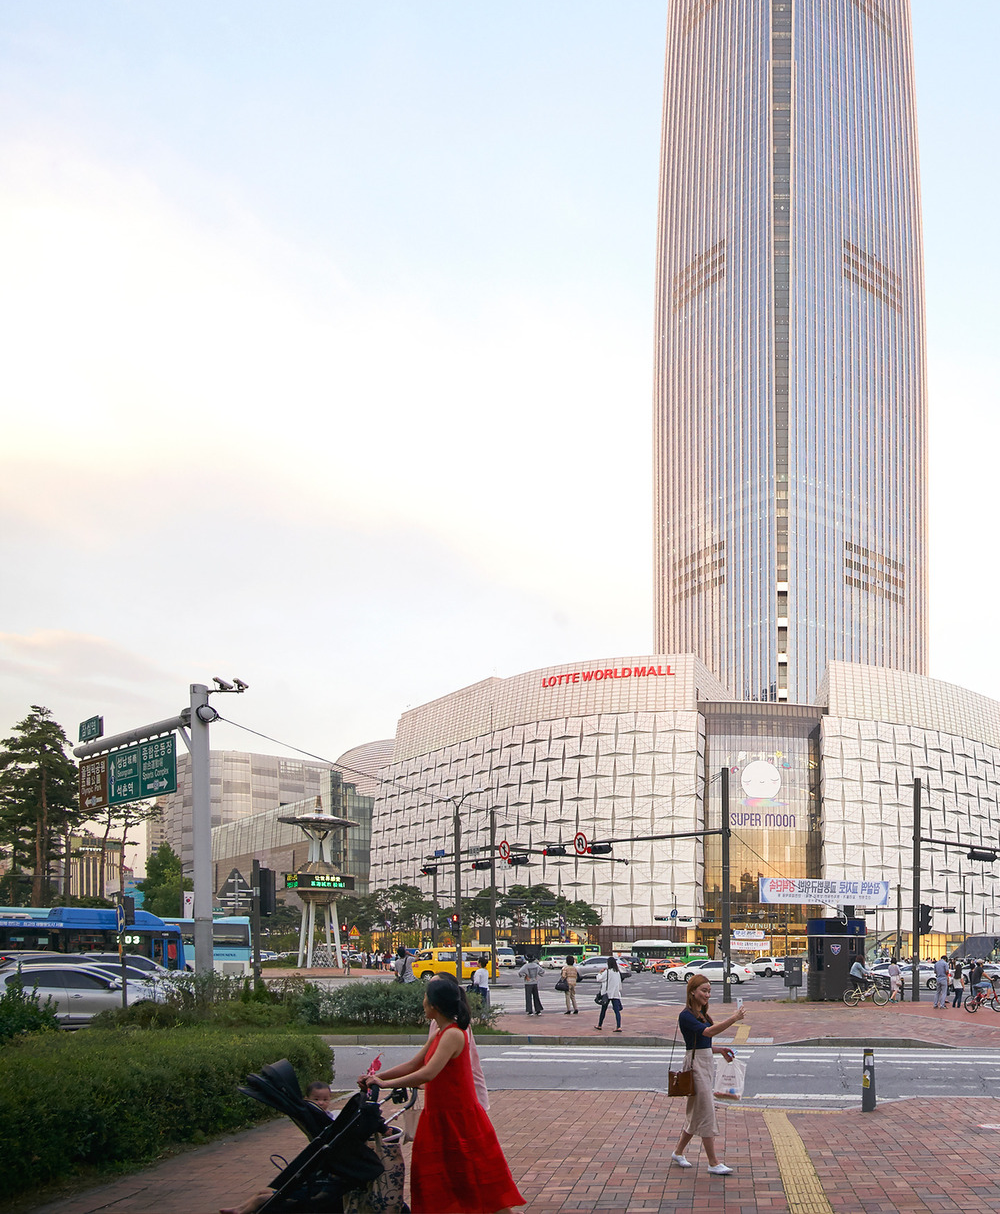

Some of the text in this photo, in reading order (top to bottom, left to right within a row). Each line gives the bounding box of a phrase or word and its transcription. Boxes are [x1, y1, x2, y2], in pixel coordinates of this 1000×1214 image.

[541, 665, 675, 688] LOTTE WORLD MALL
[142, 740, 173, 761] 종합운동장
[117, 782, 134, 797] 석촌역
[730, 812, 761, 826] SUPER
